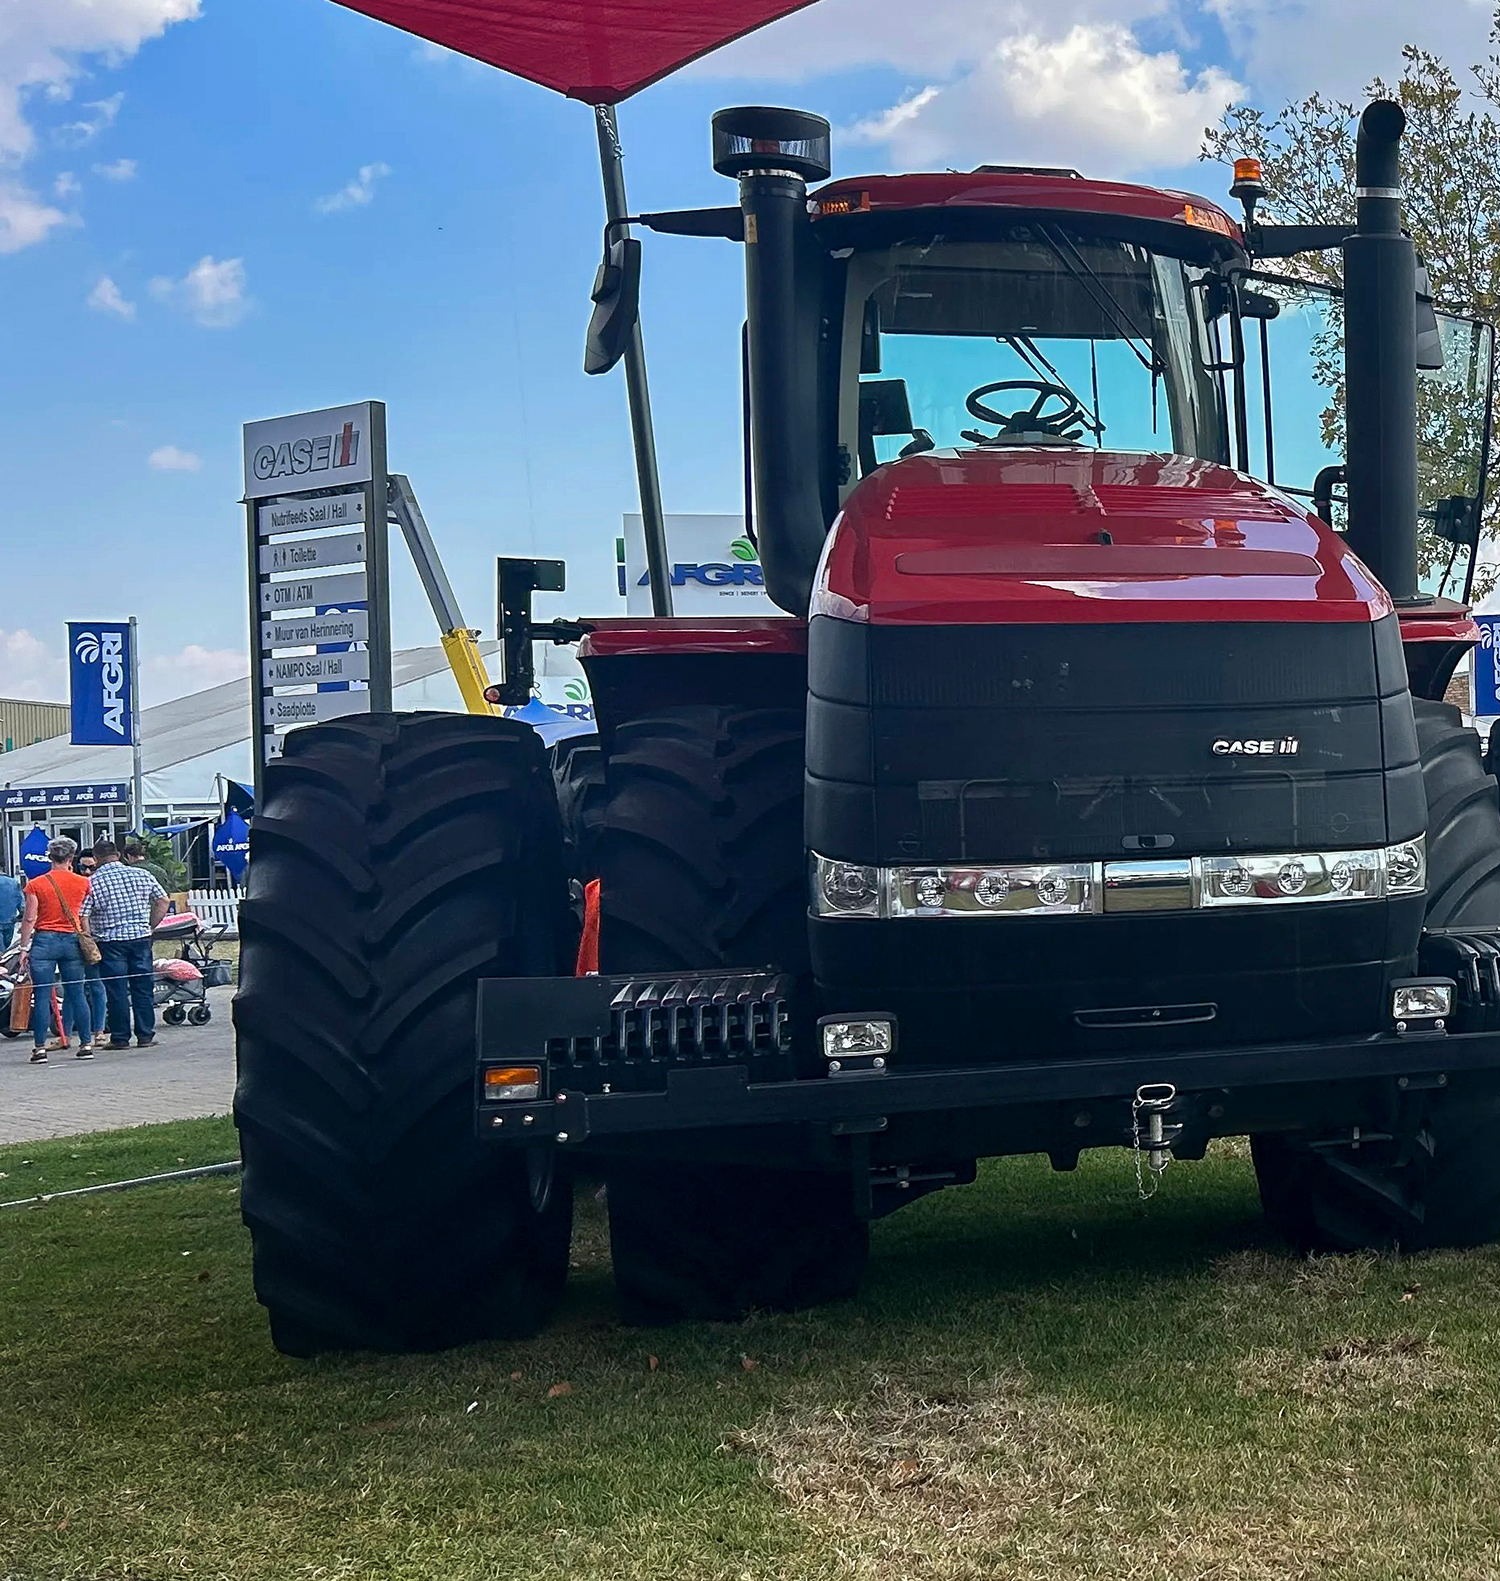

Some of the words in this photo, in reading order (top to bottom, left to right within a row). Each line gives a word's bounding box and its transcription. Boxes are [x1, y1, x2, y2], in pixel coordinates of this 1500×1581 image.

[254, 435, 332, 481] CASE
[271, 508, 307, 528] Nutrifeeds
[309, 505, 326, 522] Saal
[332, 503, 347, 519] Hall
[290, 548, 317, 563] Toilette
[637, 563, 765, 586] FGR
[274, 587, 292, 604] OTM
[296, 585, 313, 600] ATM
[275, 626, 294, 642] Muur
[296, 626, 308, 639] van
[310, 620, 354, 639] Herinnering
[275, 662, 304, 679] NAMPO
[306, 661, 322, 676] Saal
[327, 659, 342, 675] Hall
[101, 632, 125, 736] AFGRI
[277, 702, 316, 720] Saadplotte
[1212, 740, 1275, 755] CASE
